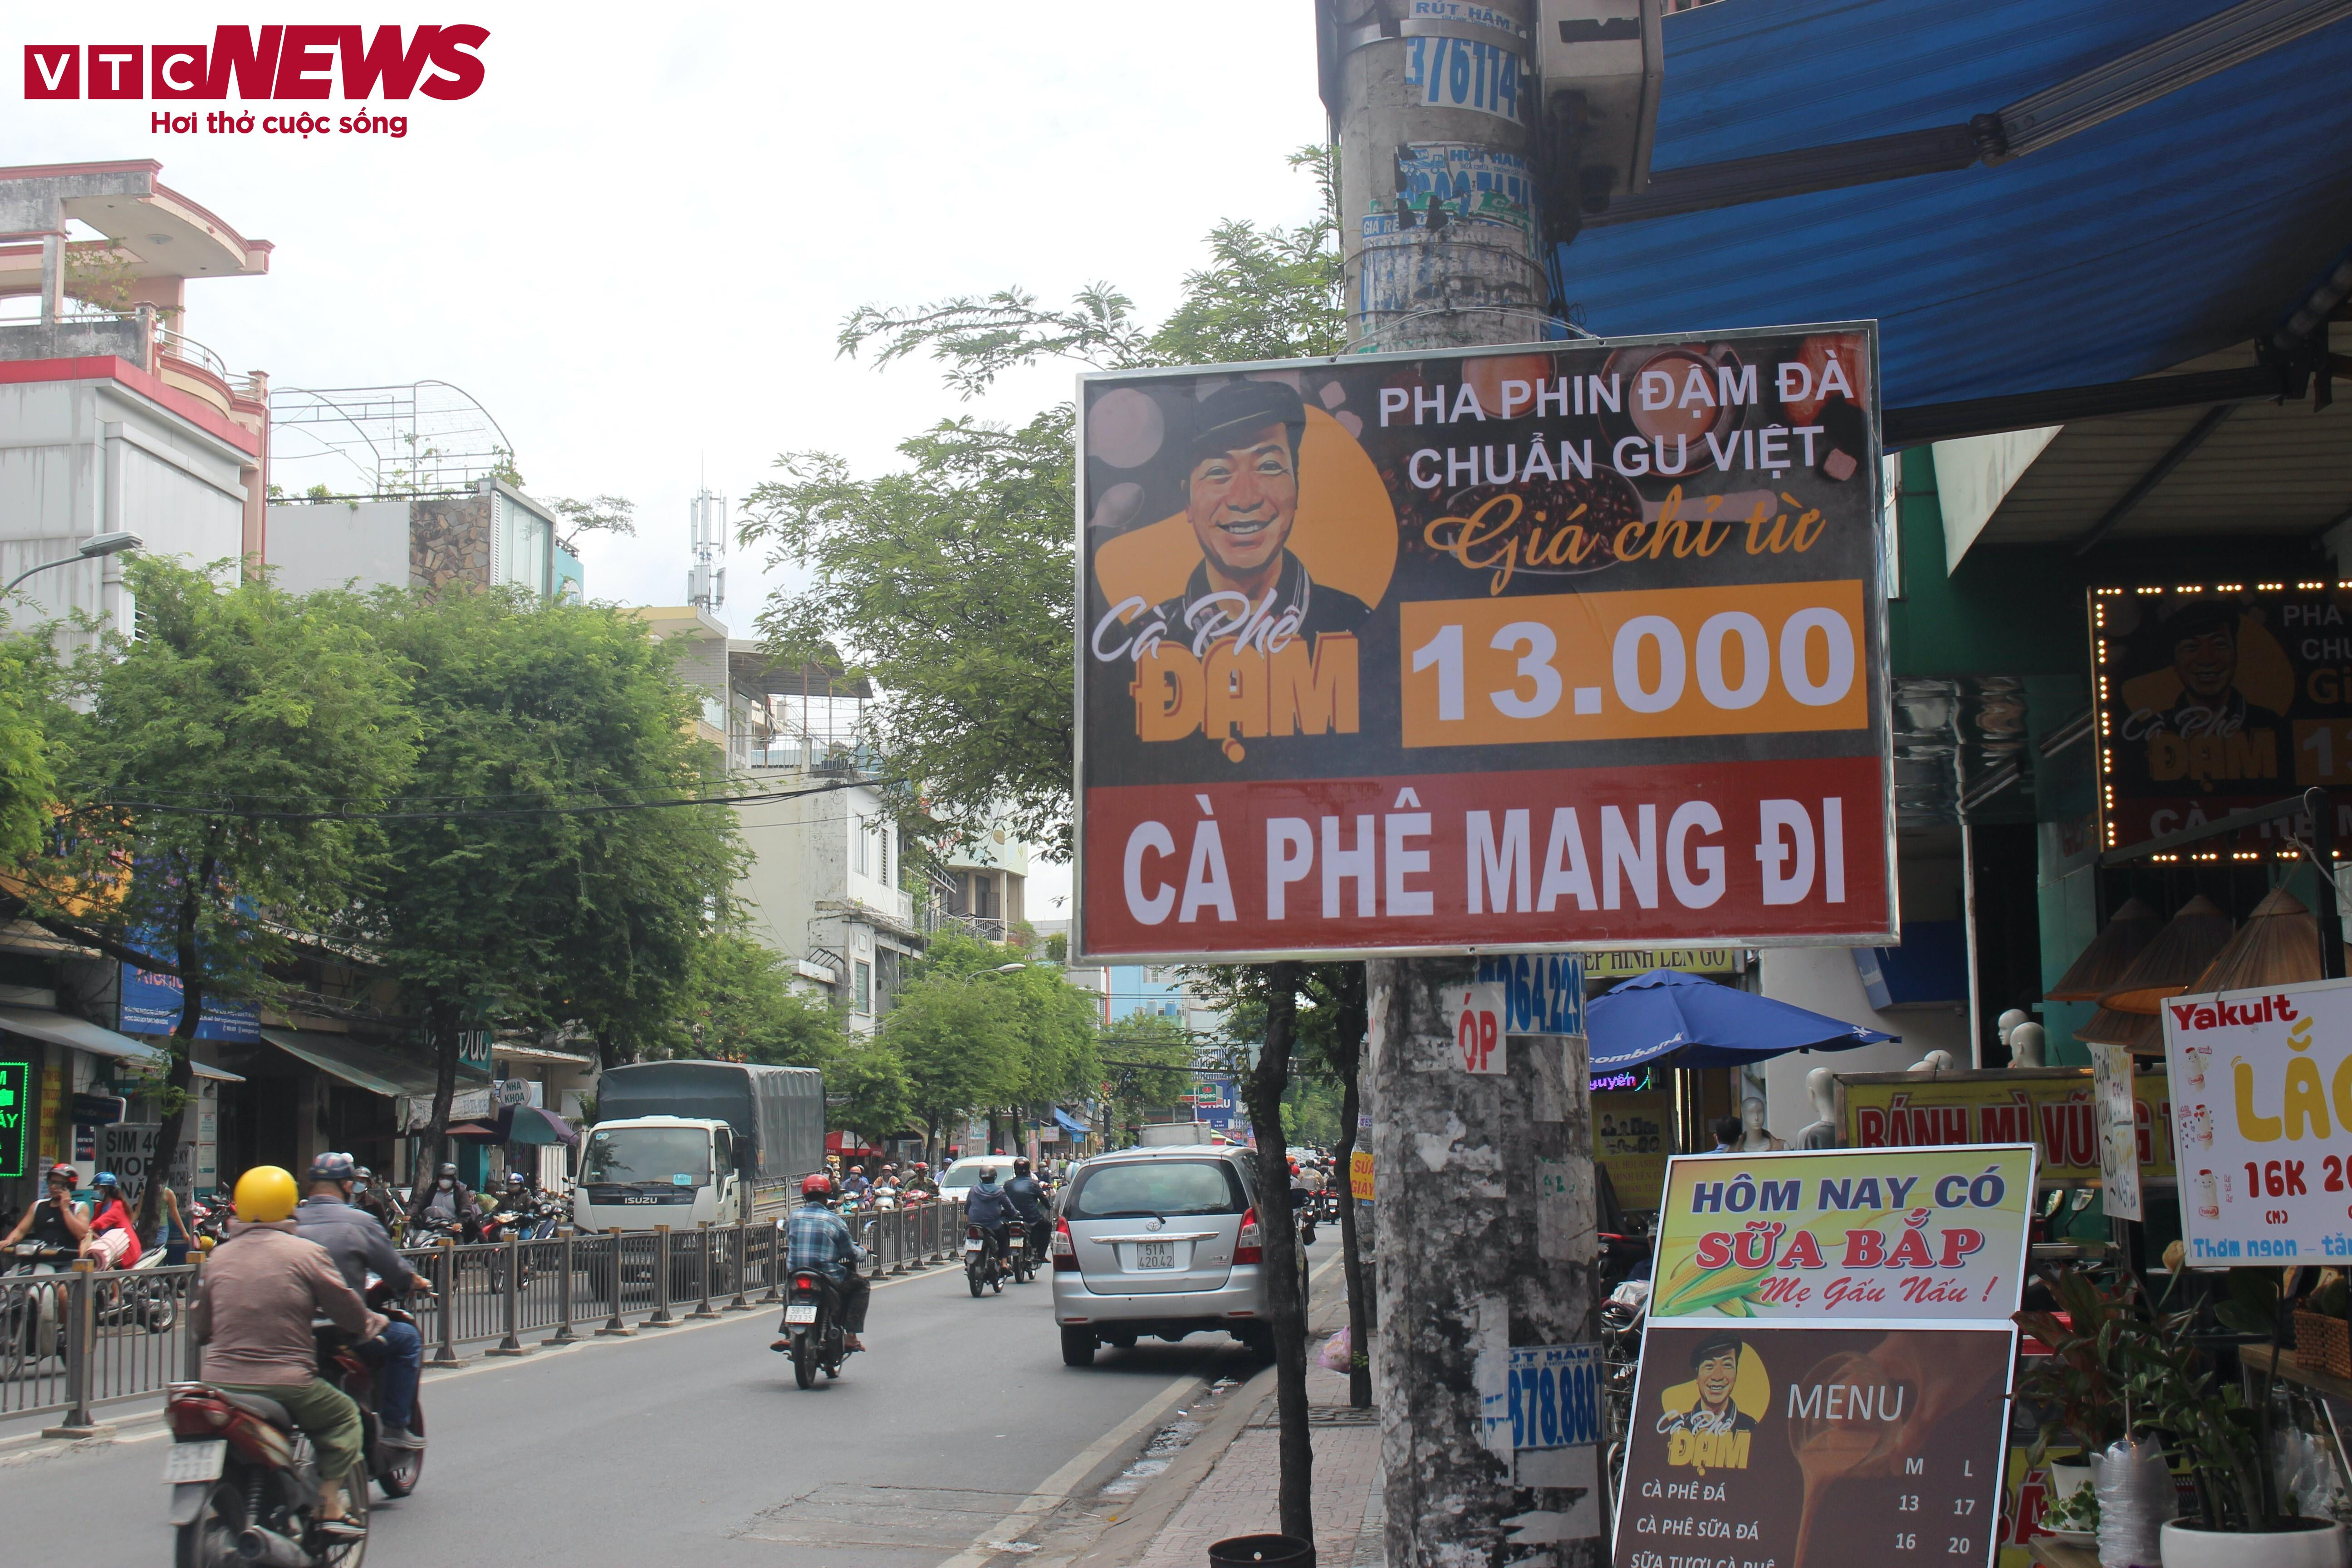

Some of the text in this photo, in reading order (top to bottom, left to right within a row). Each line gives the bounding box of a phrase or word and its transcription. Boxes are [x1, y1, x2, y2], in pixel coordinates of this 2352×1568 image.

[1379, 349, 1853, 427] PHA PHIN ĐẬM ĐÀ
[1408, 424, 1825, 490] CHUẨN GU VIỆT
[1424, 484, 1826, 596] Giá chỉ từ
[1092, 588, 1300, 662] Cà Phê
[1412, 606, 1856, 722] 13.000
[1124, 786, 1846, 926] CÀ PHÊ MANG ĐI
[2170, 994, 2298, 1031] Yakult
[505, 1092, 525, 1103] KHOA
[506, 1081, 521, 1091] NHA
[106, 1131, 136, 1153] SIM
[1860, 1094, 1968, 1147] BÁNH
[1980, 1092, 2033, 1143] MÌ
[2041, 1091, 2154, 1166] VŨG
[1691, 1165, 2005, 1213] HÔM NAY CÓ
[2244, 1159, 2307, 1198] 16K
[1145, 1244, 1165, 1255] 51A
[1696, 1207, 1985, 1270] SỮA BẮP
[2193, 1238, 2240, 1257] Thơm
[2247, 1239, 2297, 1257] ngon
[1139, 1255, 1173, 1269] 420.42
[1759, 1276, 1812, 1308] Mẹ
[1824, 1278, 1886, 1310] Gấu
[1899, 1275, 1968, 1303] Nấu
[1788, 1383, 1905, 1421] MENU
[1656, 1410, 1733, 1436] Cà Phê
[1905, 1457, 1973, 1477] M L
[1642, 1479, 1975, 1516] CÀ PHÊ ĐÁ 13 17
[1637, 1514, 1970, 1555] CÀ PHÊ SỮA ĐÁ 16 20
